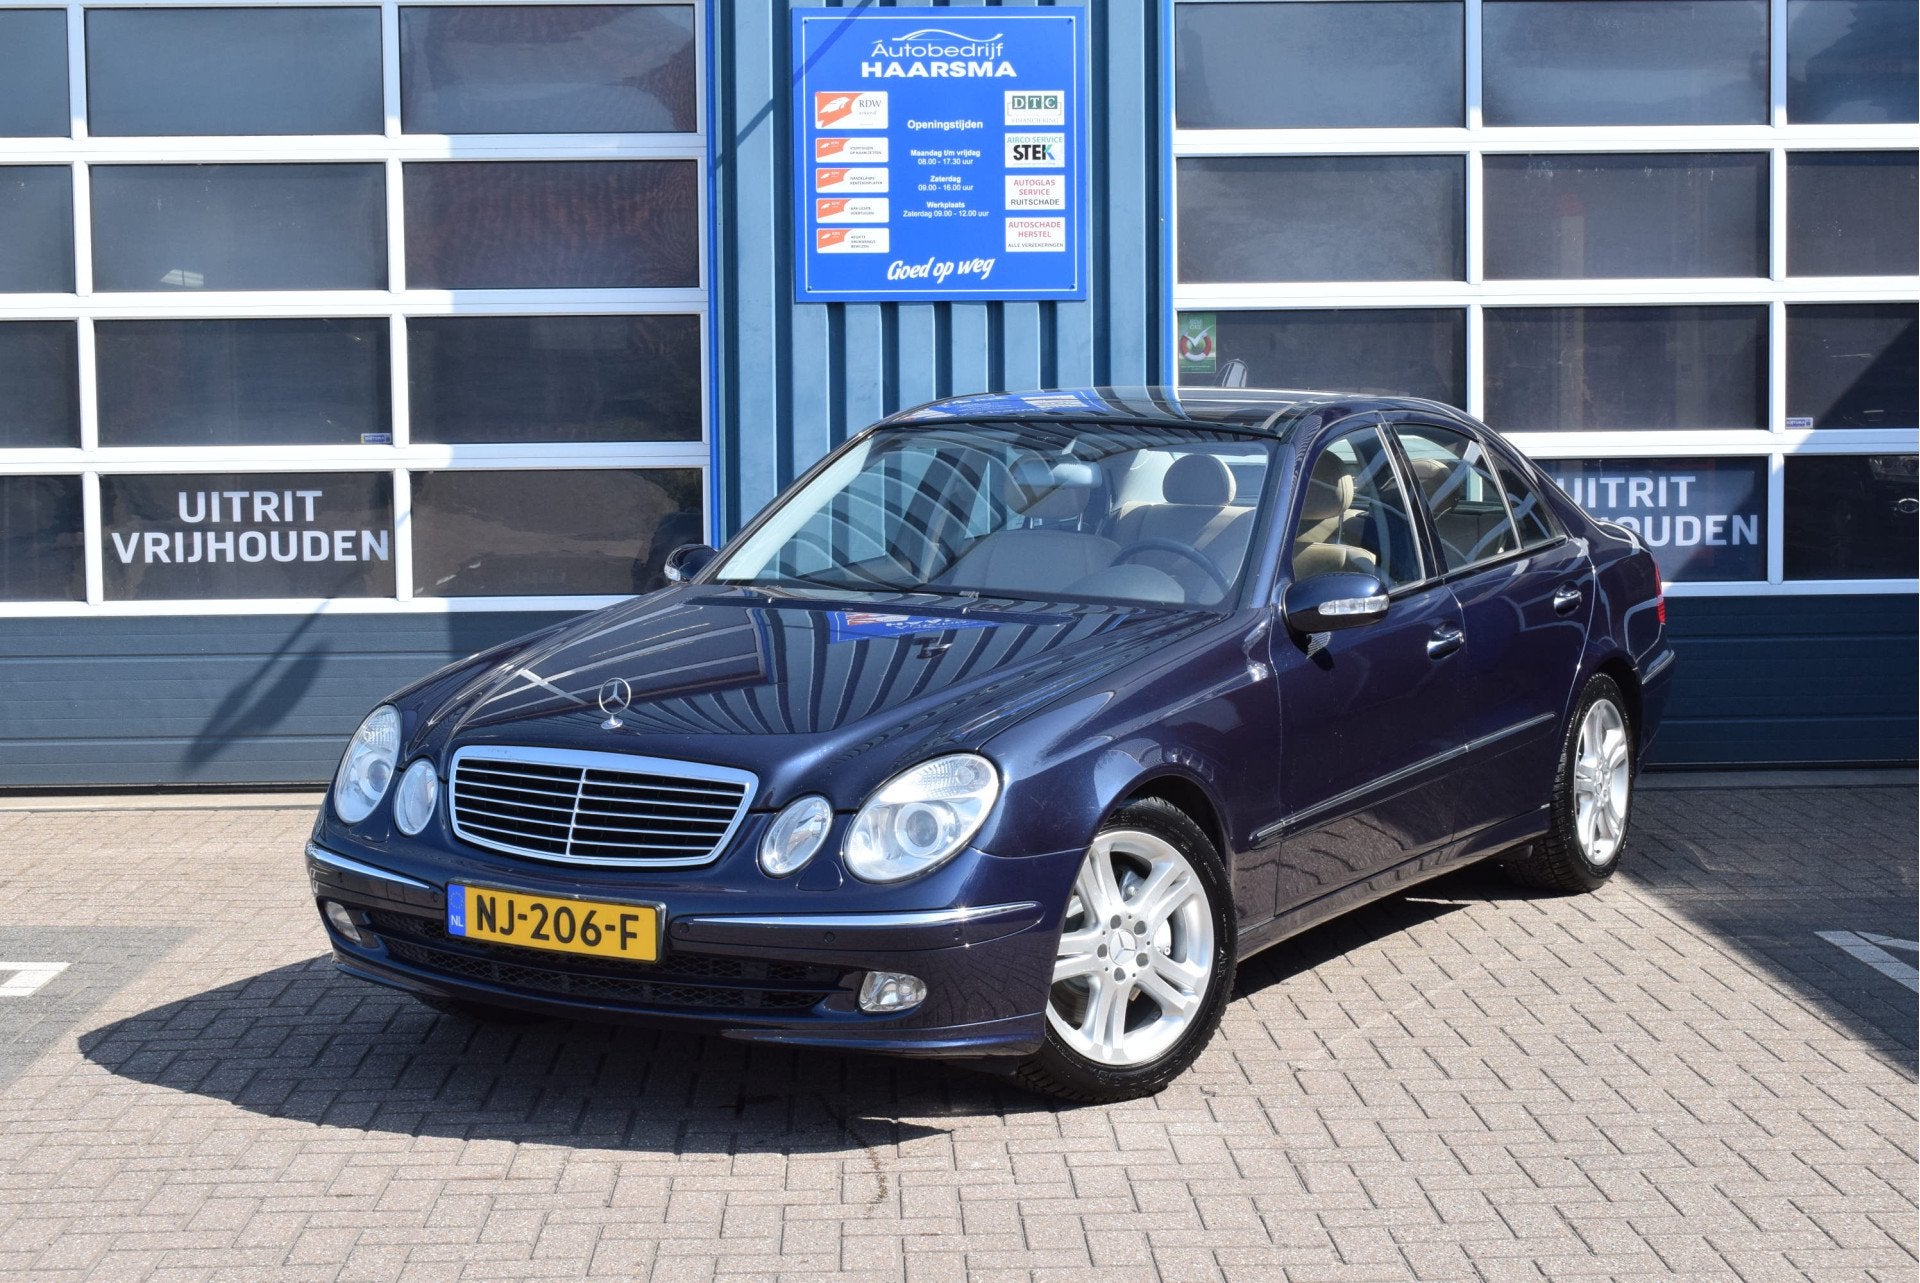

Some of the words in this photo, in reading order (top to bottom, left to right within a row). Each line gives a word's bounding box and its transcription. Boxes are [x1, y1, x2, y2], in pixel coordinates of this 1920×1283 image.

[861, 61, 1017, 77] HAARSMA
[859, 99, 882, 108] RDW
[1013, 97, 1056, 109] DTC
[907, 119, 983, 131] Openingstijden
[910, 149, 942, 158] Maandag
[956, 149, 981, 158] vrijdag
[1013, 144, 1056, 161] STEK
[930, 175, 961, 184] Zaterdag
[1013, 179, 1056, 187] AUTOGLAS
[1018, 188, 1050, 196] SERVICE
[926, 201, 965, 210] Werkplaats
[903, 210, 932, 218] Zaterdag
[887, 256, 935, 280] Goed
[932, 261, 955, 284] op
[957, 258, 996, 280] weg
[1556, 475, 1696, 508] UITRIT
[178, 490, 323, 523] UITRIT
[111, 529, 389, 564] VRIJHOUDEN
[450, 914, 464, 928] NL
[476, 894, 639, 951] NJ-206-F
